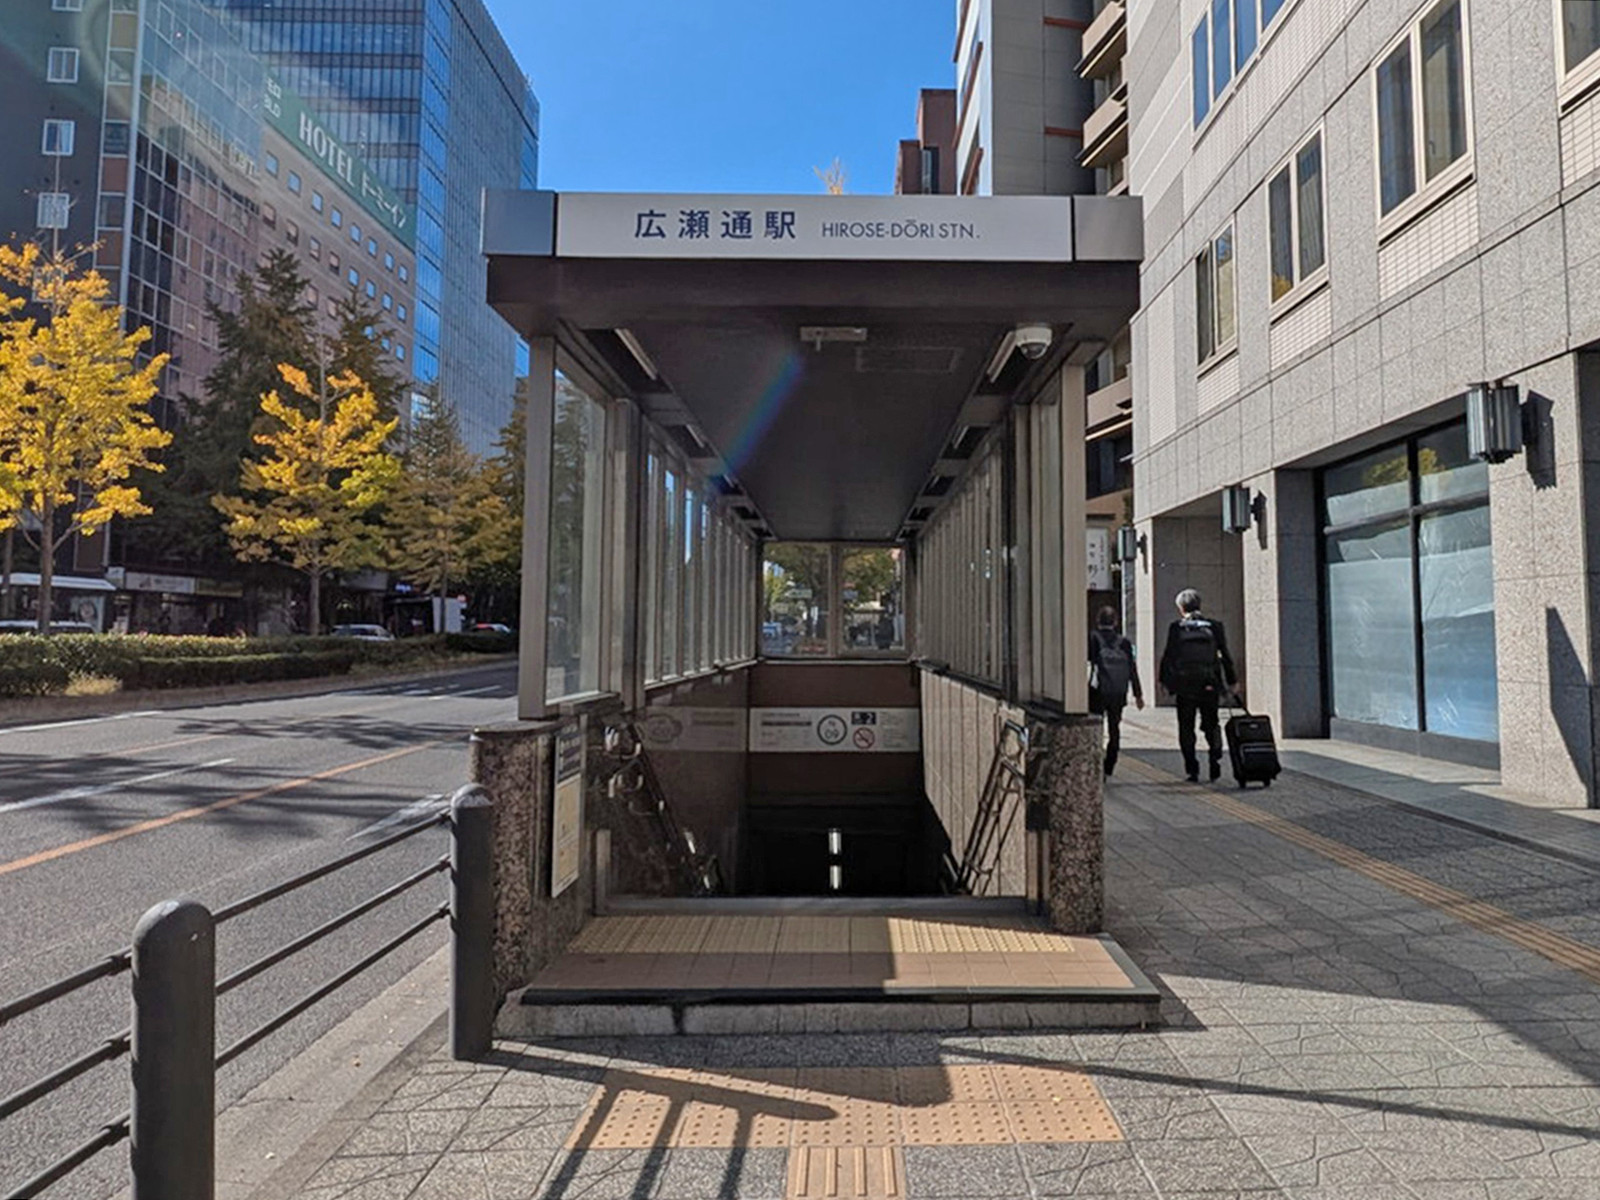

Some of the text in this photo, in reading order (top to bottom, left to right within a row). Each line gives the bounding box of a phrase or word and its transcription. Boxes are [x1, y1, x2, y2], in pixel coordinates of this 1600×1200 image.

[300, 113, 354, 187] HOTEL
[635, 209, 796, 239] 広瀬通駅
[938, 223, 981, 239] STN.
